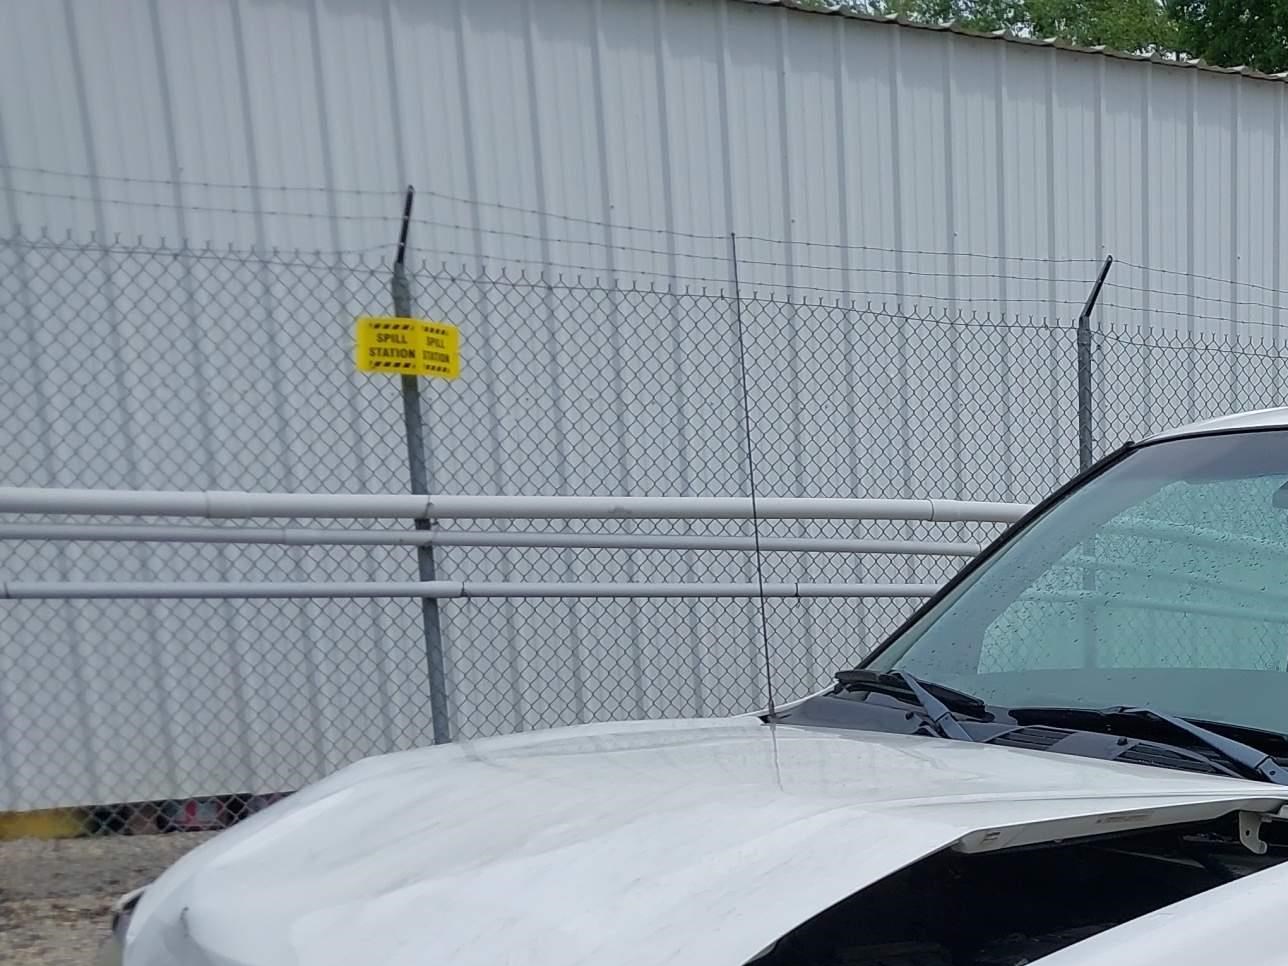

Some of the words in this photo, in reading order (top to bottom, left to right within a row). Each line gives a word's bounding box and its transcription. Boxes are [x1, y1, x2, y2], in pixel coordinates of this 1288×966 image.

[376, 333, 408, 344] SPILL
[426, 336, 445, 349] SPILL
[369, 347, 416, 359] STATION
